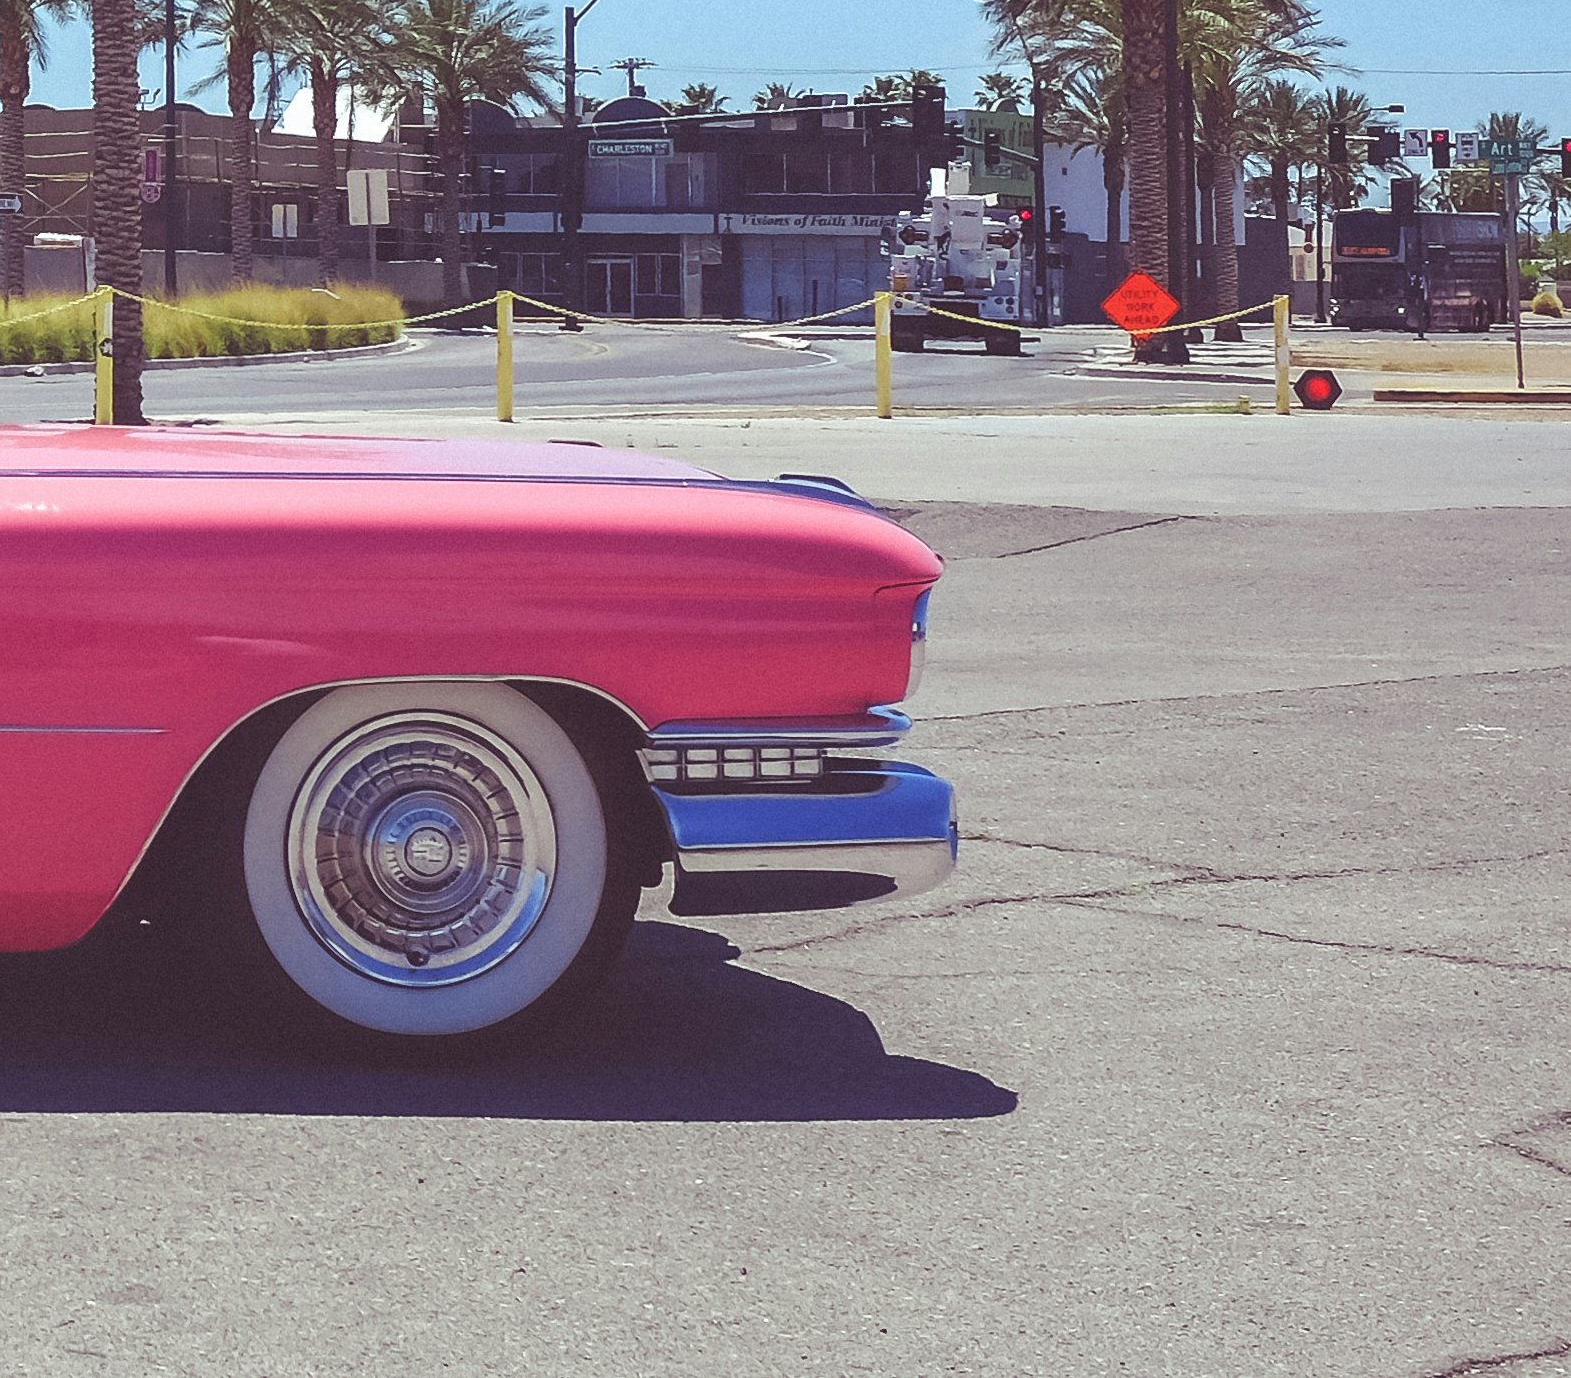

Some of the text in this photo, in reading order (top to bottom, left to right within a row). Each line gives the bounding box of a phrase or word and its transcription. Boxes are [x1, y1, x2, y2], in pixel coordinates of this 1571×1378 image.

[597, 144, 652, 154] CHARLESTON
[1491, 141, 1513, 156] Art
[741, 214, 897, 229] Visions of Faith Minist
[1120, 290, 1158, 299] UTILITY
[1126, 303, 1154, 312] WORK
[1124, 315, 1160, 325] AHEAD
